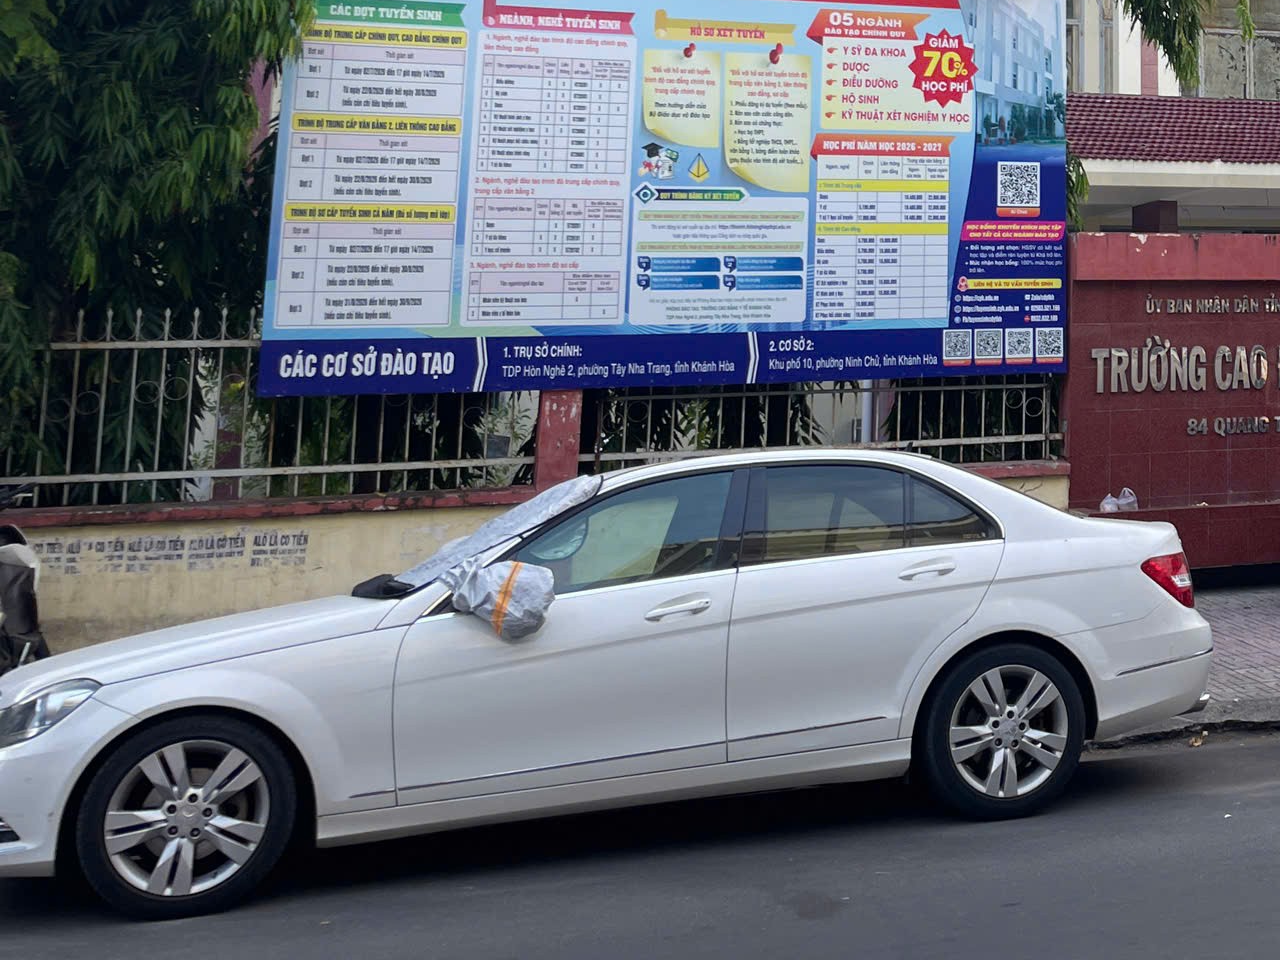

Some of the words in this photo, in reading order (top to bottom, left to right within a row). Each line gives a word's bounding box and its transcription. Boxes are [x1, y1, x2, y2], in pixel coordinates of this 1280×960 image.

[330, 5, 351, 15] CÁC
[378, 5, 414, 20] TUYỂN
[416, 10, 442, 21] SINH
[829, 12, 854, 26] 05
[857, 16, 902, 28] NGÀNH
[499, 13, 535, 27] NGÀNH,
[566, 14, 596, 29] TUYỂN
[599, 19, 621, 30] SINH
[736, 25, 765, 39] TUYỂN
[929, 36, 958, 49] GIẢM
[843, 46, 849, 56] Y
[865, 47, 877, 57] ĐA
[881, 47, 906, 57] KHOA
[843, 62, 870, 75] DƯỢC
[923, 51, 968, 78] 70%
[842, 75, 862, 88] ĐIỀU
[865, 77, 899, 89] DƯỠNG
[922, 81, 947, 94] HỌC
[950, 81, 968, 93] PHÍ
[842, 94, 856, 106] HỘ
[858, 94, 880, 104] SINH
[856, 110, 883, 123] THUẬT
[886, 110, 902, 121] XÉT
[904, 110, 939, 124] NGHIỆM
[941, 113, 947, 122] Y
[949, 113, 970, 126] HỌC
[823, 141, 840, 151] HỌC
[841, 139, 856, 150] PHÍ
[857, 140, 877, 150] NĂM
[879, 142, 895, 152] HỌC
[896, 142, 916, 151] 2026
[923, 143, 942, 152] 2027
[1146, 294, 1163, 314] ỦY
[1166, 298, 1193, 314] BAN
[1196, 296, 1230, 314] NHÂN
[1234, 294, 1259, 313] DÂN
[503, 347, 511, 358] 1.
[514, 346, 533, 360] TRỤ
[535, 341, 550, 358] SỞ
[551, 342, 583, 358] CHÍNH:
[769, 341, 777, 352] 2.
[779, 339, 792, 352] CƠ
[794, 336, 805, 351] SỞ
[806, 340, 814, 351] 2:
[279, 350, 317, 378] CÁC
[322, 351, 348, 377] CƠ
[351, 346, 378, 377] SỞ
[380, 348, 417, 376] ĐÀO
[422, 351, 455, 380] TẠO
[502, 365, 521, 378] TDP
[523, 363, 541, 378] Hòn
[543, 364, 566, 380] Nghê
[567, 364, 576, 378] 2,
[577, 364, 609, 379] phường
[611, 363, 627, 378] Tây
[628, 363, 645, 374] Nha
[647, 362, 673, 377] Trang,
[691, 360, 717, 373] Khánh
[719, 360, 735, 372] Hòa
[769, 358, 785, 370] Khu
[786, 356, 801, 371] phố
[803, 358, 814, 371] 10,
[816, 356, 844, 371] phường
[845, 356, 863, 367] Ninh
[898, 354, 922, 366] Khánh
[923, 353, 938, 365] Hòa
[1091, 335, 1207, 393] TRƯỜNG
[1213, 344, 1269, 391] CAO
[1186, 418, 1209, 436] 84
[1213, 416, 1270, 436] QUANG
